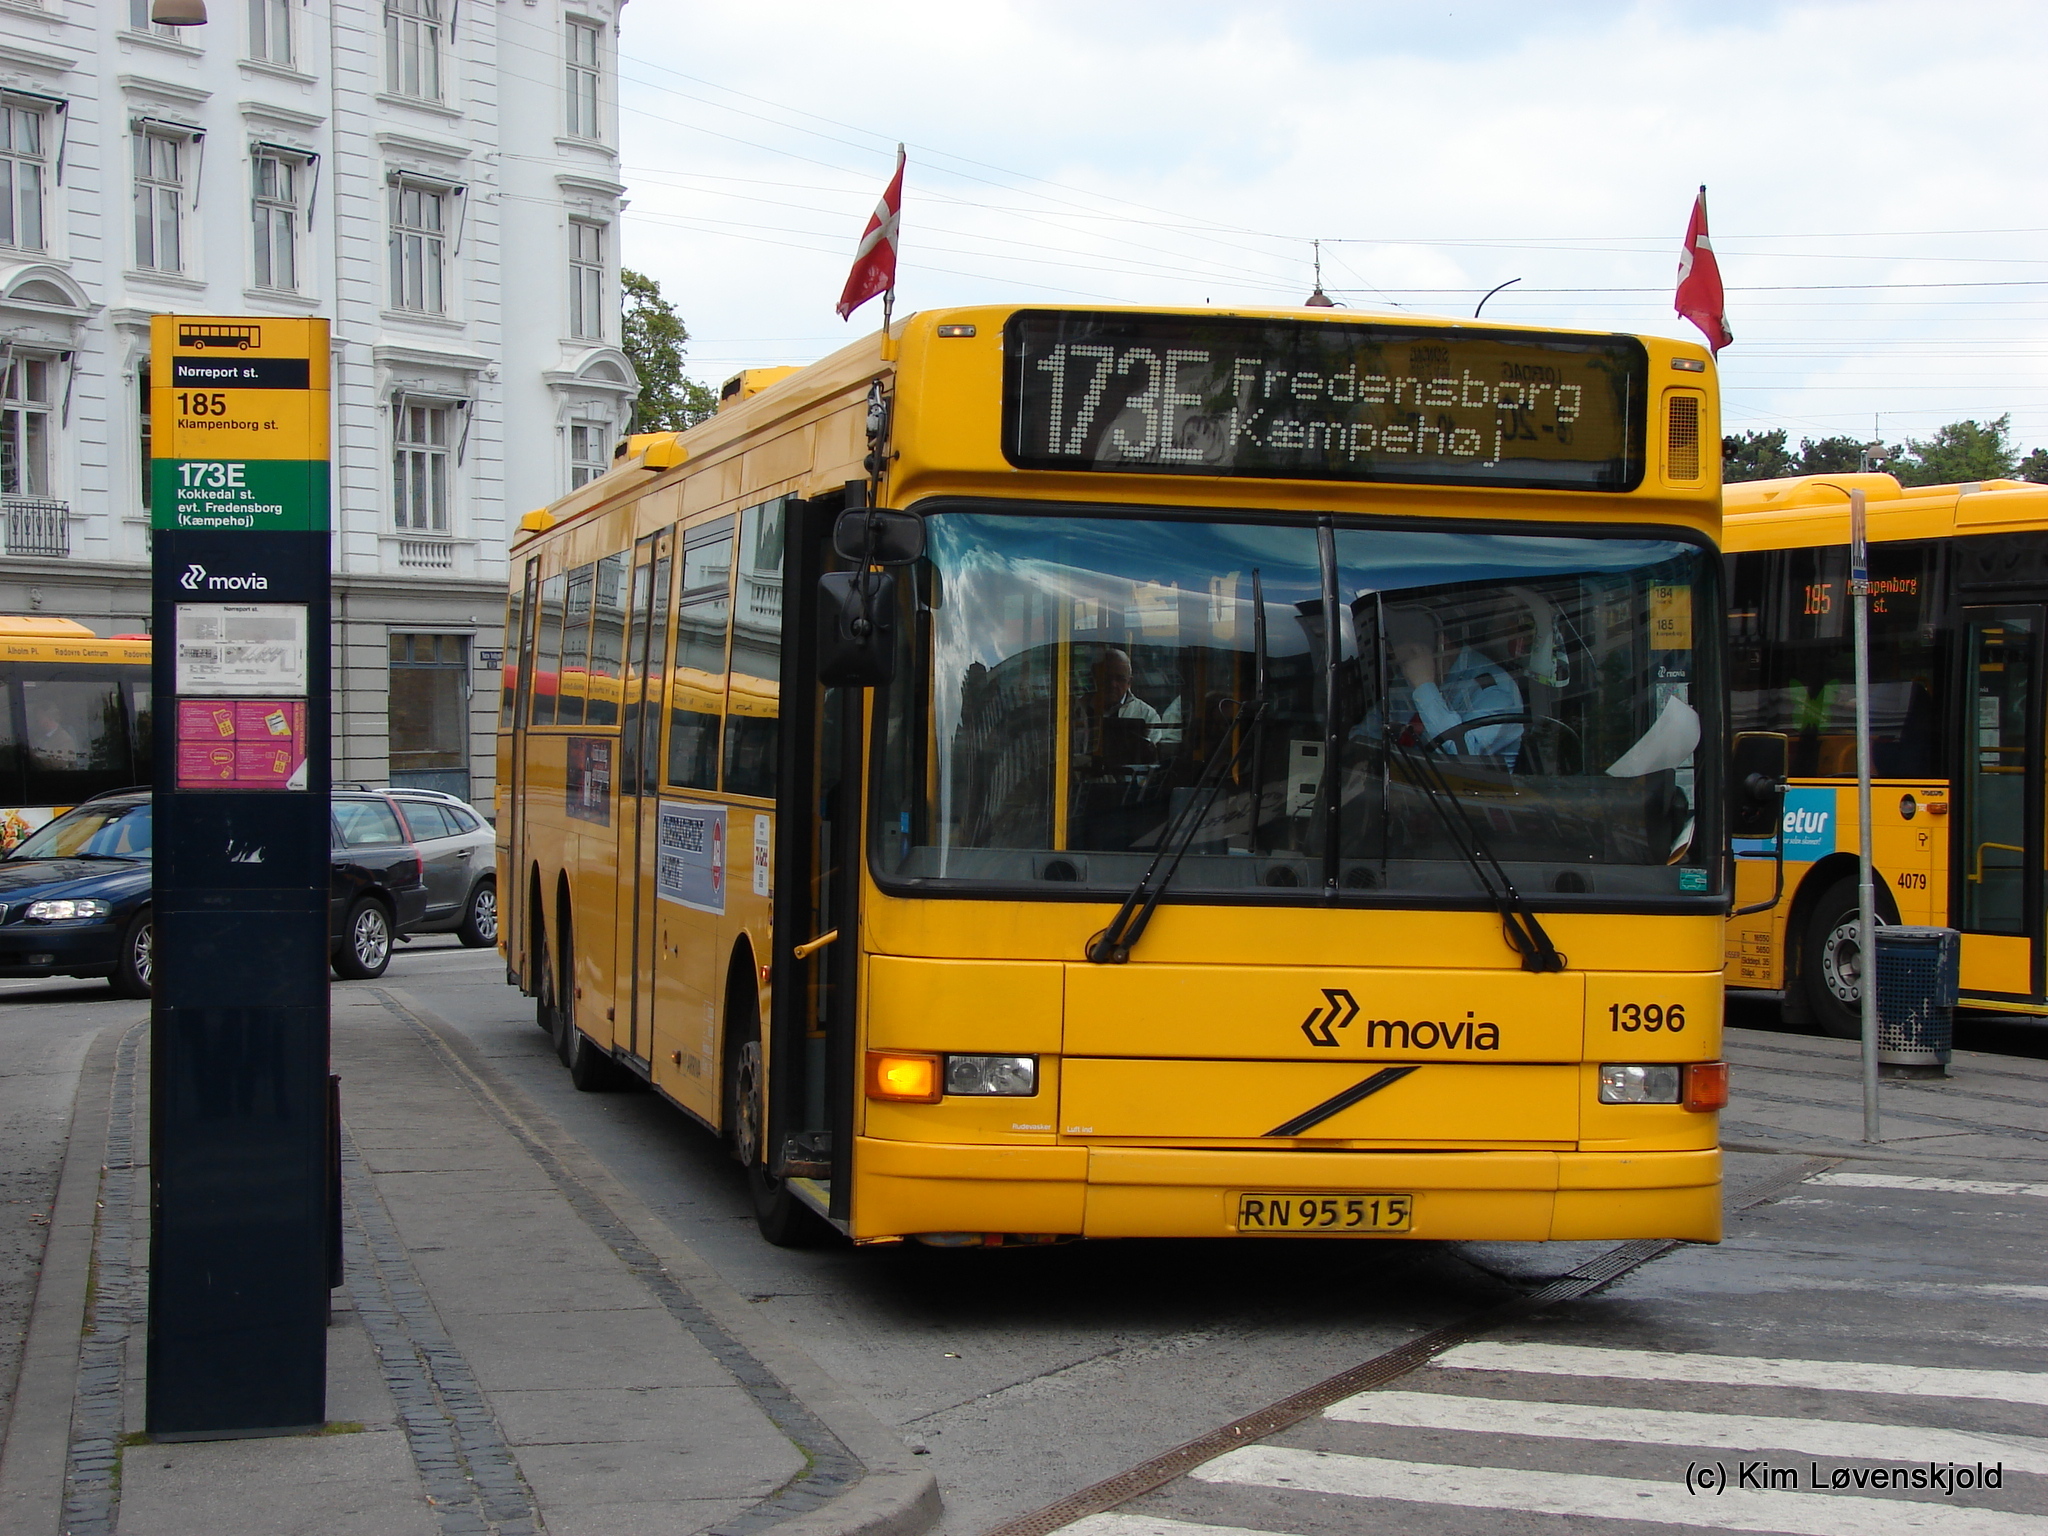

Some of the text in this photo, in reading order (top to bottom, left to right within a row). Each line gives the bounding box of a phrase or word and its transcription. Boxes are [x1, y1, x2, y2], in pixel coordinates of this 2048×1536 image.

[178, 366, 259, 379] Nørreport st.
[1234, 357, 1582, 424] Fredensborg
[177, 392, 227, 416] 185
[1037, 343, 1210, 461] 173E
[178, 419, 279, 431] Klampenborg st.
[1230, 406, 1503, 469] Kæmpehøj
[178, 463, 246, 488] 173E
[178, 489, 256, 500] Kokkedal st.
[178, 502, 283, 515] evt. Fredensborg
[178, 514, 254, 528] (Kæmpehøj)
[208, 572, 268, 590] movia
[1655, 587, 1673, 599] 184
[1803, 583, 1832, 615] 185
[1873, 597, 1888, 613] st.
[1656, 619, 1674, 630] 185
[82, 649, 109, 657] Centrum
[1897, 873, 1927, 889] 4079
[1608, 1002, 1687, 1034] 1396
[1366, 1010, 1500, 1051] movia
